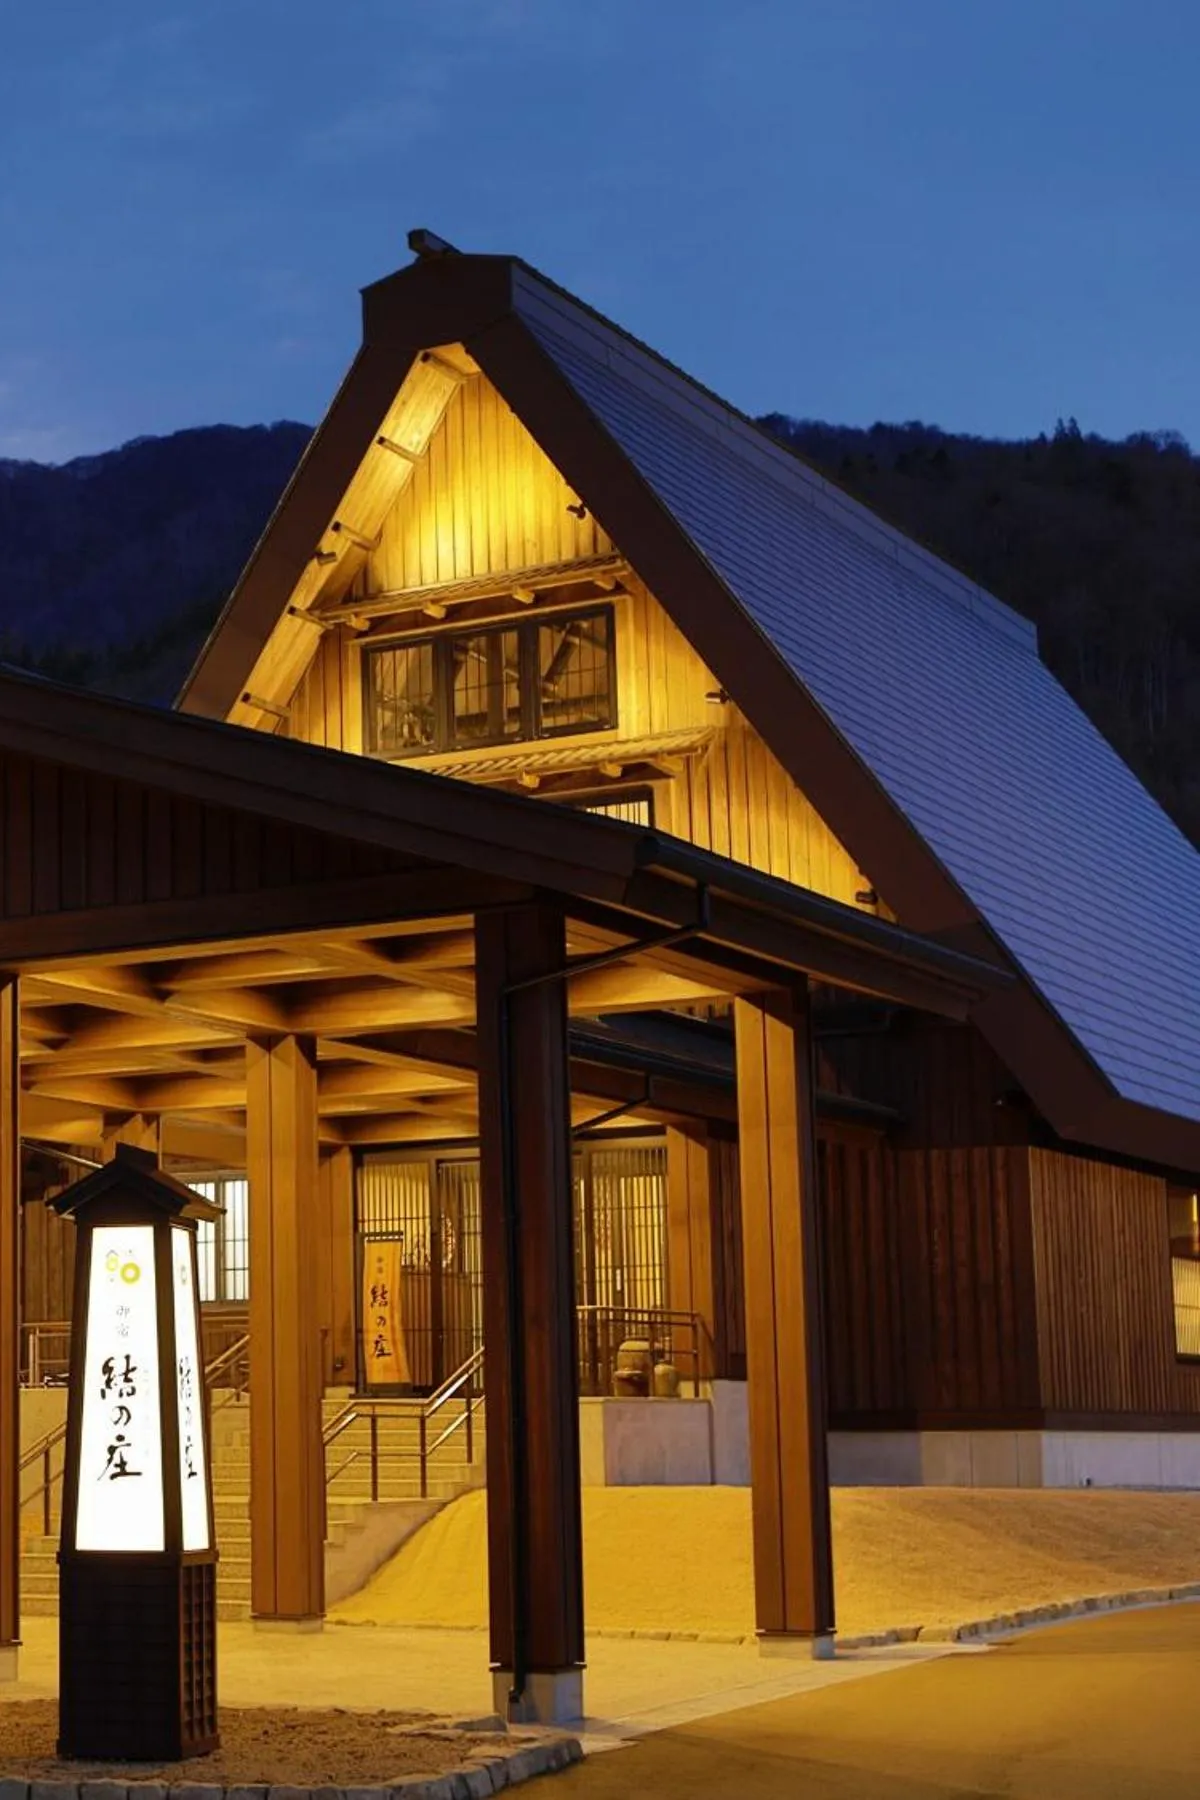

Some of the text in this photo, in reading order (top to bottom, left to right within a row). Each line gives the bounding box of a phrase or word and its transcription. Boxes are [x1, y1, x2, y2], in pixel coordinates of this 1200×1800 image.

[369, 1283, 392, 1358] 結の庄
[97, 1353, 143, 1481] 結の庄
